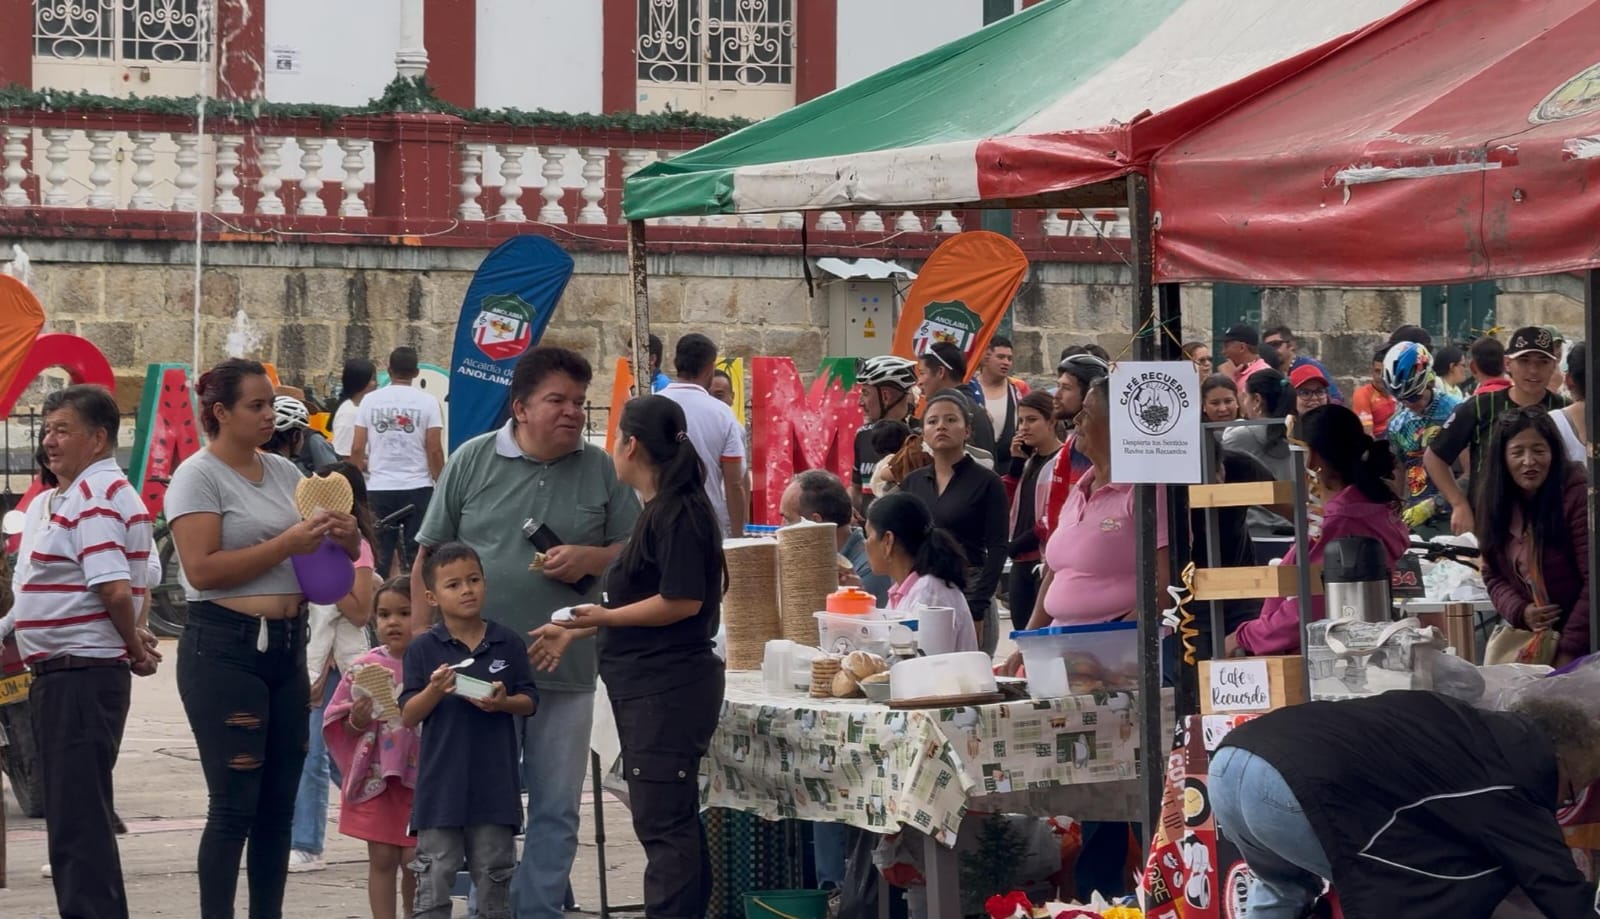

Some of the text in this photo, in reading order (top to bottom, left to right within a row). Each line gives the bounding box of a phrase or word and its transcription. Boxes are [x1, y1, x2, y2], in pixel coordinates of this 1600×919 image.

[1120, 371, 1190, 408] CAFÉ RECUERDO
[1212, 684, 1267, 706] Recuerdo
